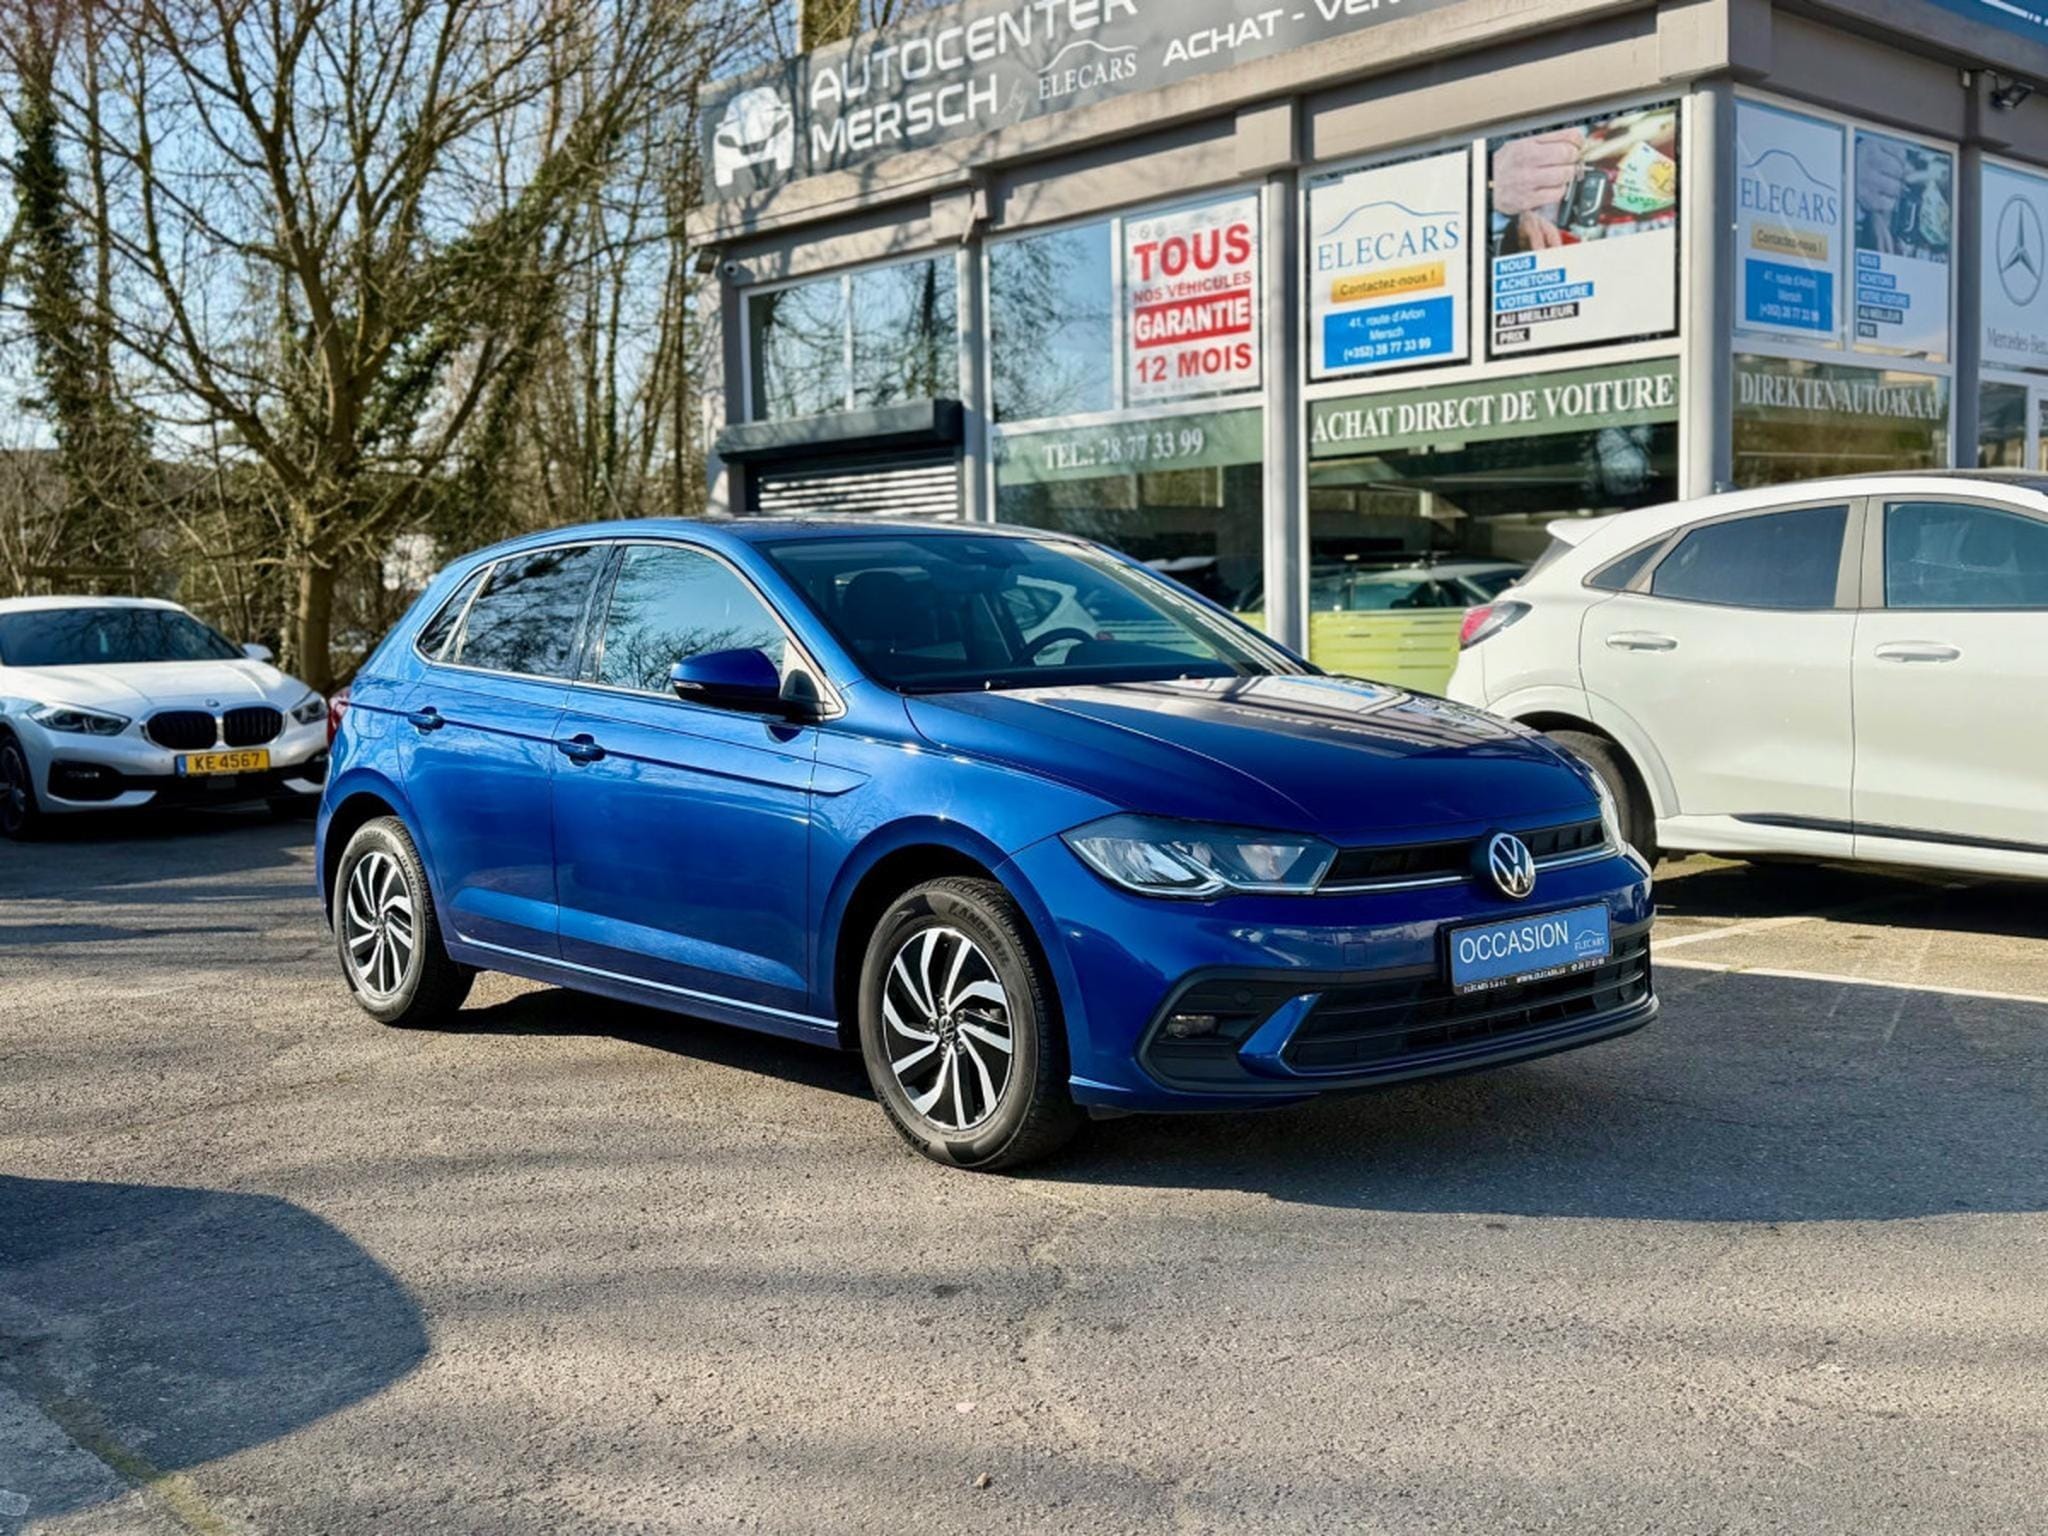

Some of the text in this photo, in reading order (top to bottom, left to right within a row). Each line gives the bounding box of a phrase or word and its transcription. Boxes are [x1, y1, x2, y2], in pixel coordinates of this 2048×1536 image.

[1162, 9, 1284, 66] ACHAT
[811, 73, 997, 161] MERSCH
[1039, 52, 1136, 100] ELECARS
[1741, 177, 1838, 226] ELECARS
[1133, 224, 1251, 282] TOUS
[1318, 221, 1460, 271] ELECARS
[1500, 257, 1531, 273] NOUS
[1134, 287, 1163, 303] NOS
[1340, 273, 1427, 296] Contactez-nous
[1500, 270, 1560, 289] ACHETONS
[1500, 284, 1588, 309] VOTRE VOITURE
[1135, 297, 1249, 342] GARANTIE
[1136, 343, 1252, 383] 12 MOIS
[1311, 373, 1675, 443] ACHAT DIRECT DE VOITURE
[1101, 436, 1121, 465] 28
[1127, 434, 1148, 461] 77
[1152, 431, 1174, 459] 33
[1180, 428, 1203, 456] 99
[195, 753, 261, 770] KE 4567
[1459, 920, 1569, 964] OCCASION
